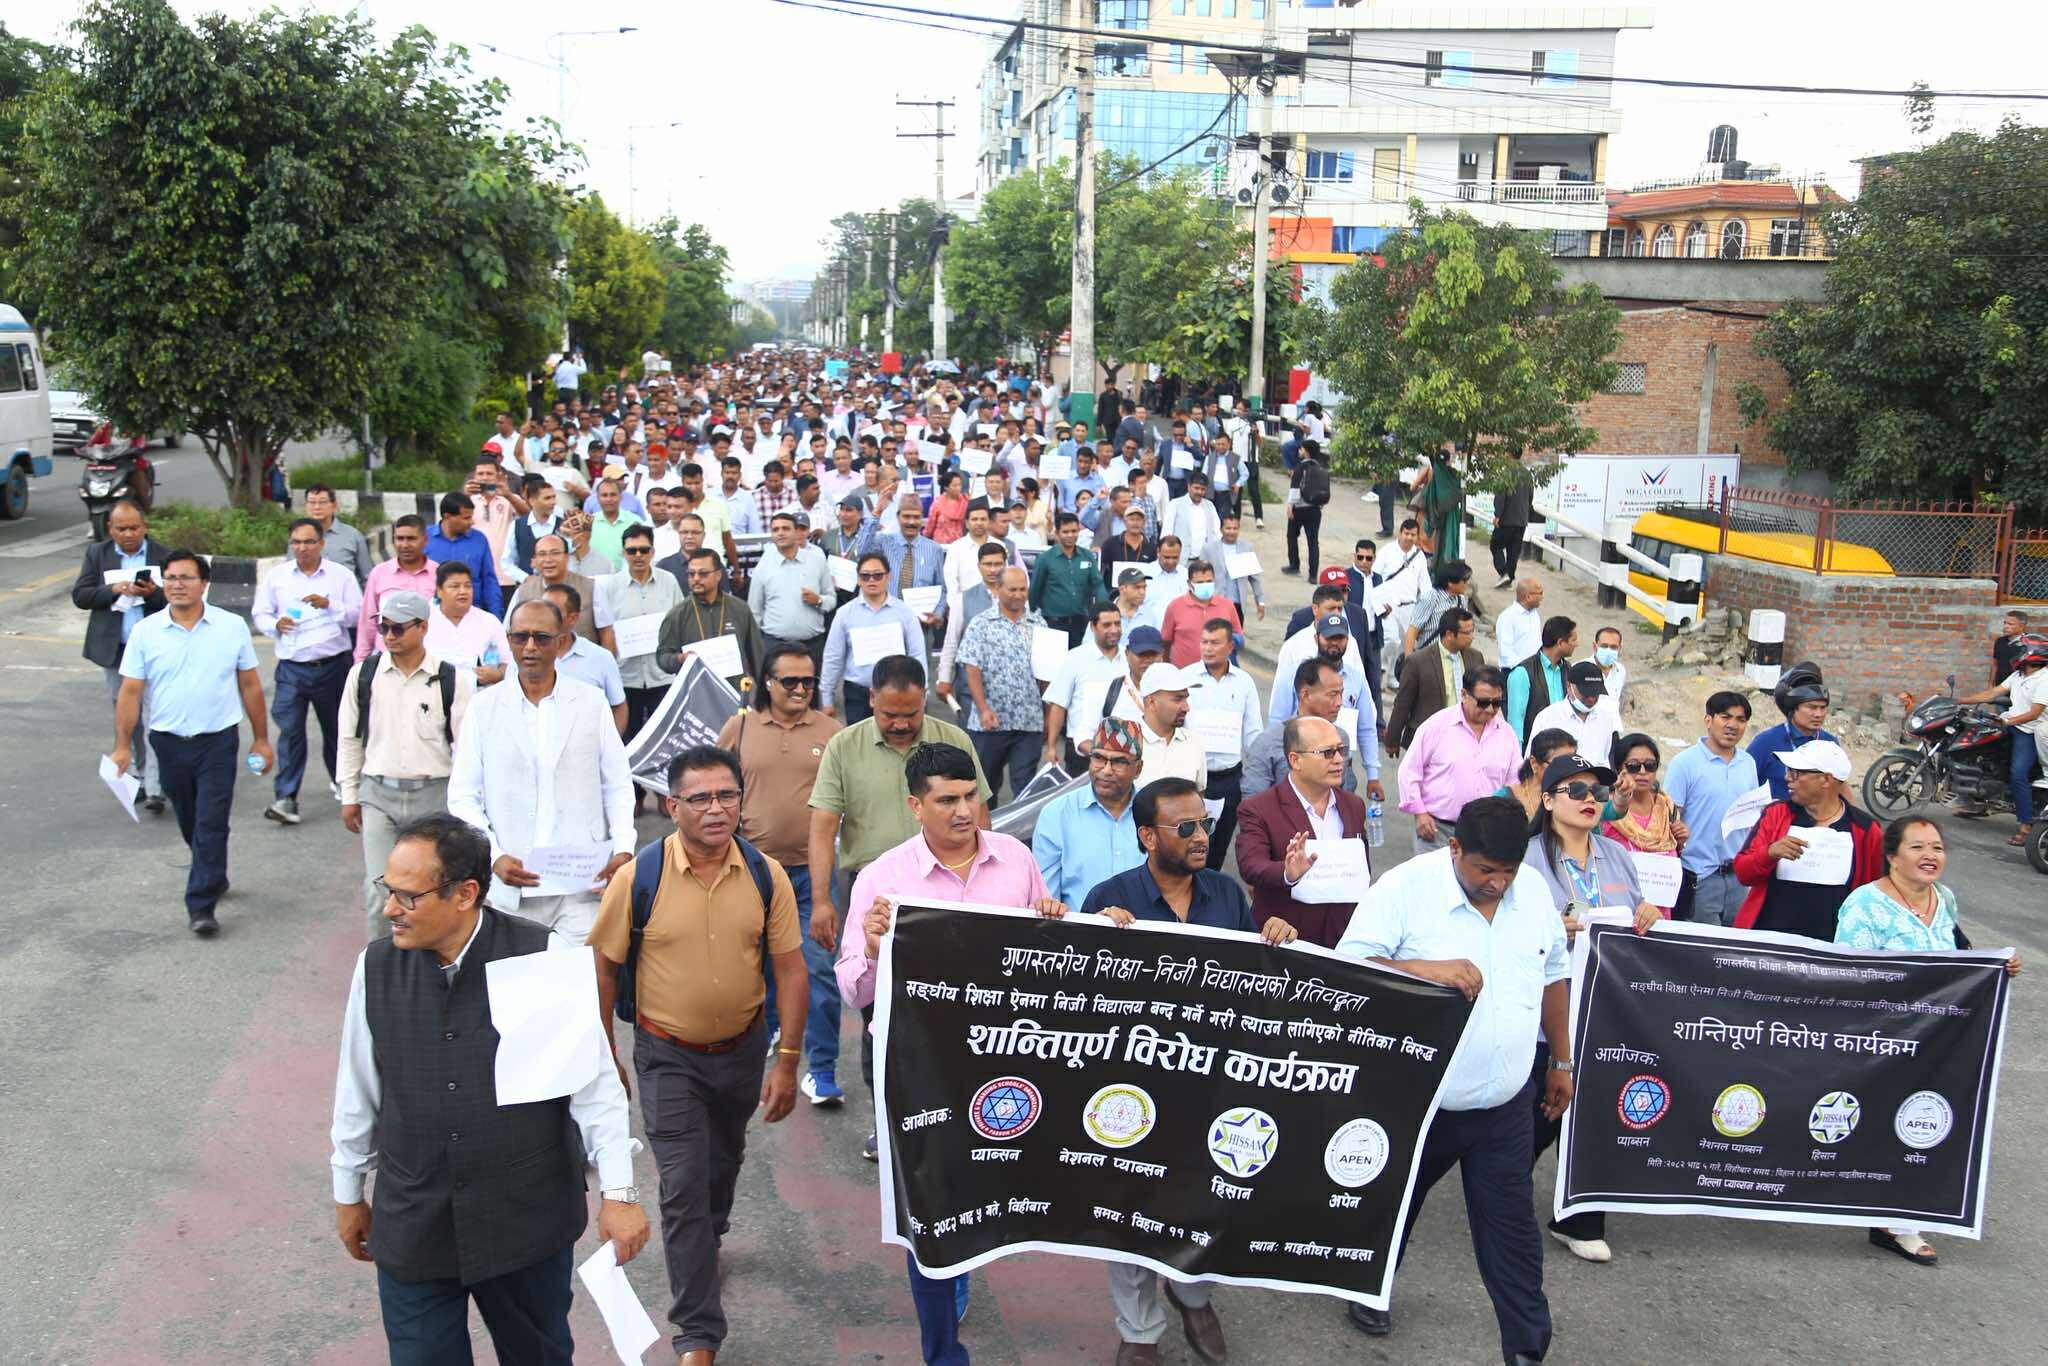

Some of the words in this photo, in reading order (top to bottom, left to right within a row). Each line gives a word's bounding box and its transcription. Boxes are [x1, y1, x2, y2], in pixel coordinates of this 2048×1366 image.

[1626, 488, 1648, 496] MEGA
[1649, 488, 1683, 496] COLLEGE
[1001, 945, 1091, 977] गुणस्तरीय
[1200, 960, 1292, 999] विद्यालयको
[1665, 981, 1687, 994] शिक्षा
[1690, 984, 1714, 996] ऐनमा
[905, 980, 959, 1003] सङ्घीय
[965, 982, 1004, 1006] शिक्षा
[1010, 987, 1049, 1011] ऐनमा
[1053, 990, 1088, 1013] निजी
[1092, 993, 1147, 1016] विद्यालय
[1150, 1001, 1176, 1021] बन्द
[1181, 1004, 1204, 1024] गर्ने
[1209, 1007, 1236, 1031] गरी
[1240, 1014, 1284, 1036] ल्याउन
[1287, 1017, 1345, 1043] लागिएको
[1348, 1026, 1396, 1051] नीतिका
[1673, 1016, 1764, 1050] शान्तिपूर्ण
[1768, 1021, 1828, 1050] विरोध
[1833, 1031, 1920, 1057] कार्यक्रम
[967, 1018, 1120, 1069] शान्तिपूर्ण
[1123, 1023, 1219, 1076] विरोध
[1223, 1050, 1359, 1094] कार्यक्रम
[1905, 1120, 1937, 1131] APEN
[1228, 1133, 1263, 1151] HISSAN
[1617, 1135, 1651, 1148] प्याब्सन
[1700, 1137, 1729, 1151] नेशनल
[1731, 1142, 1763, 1155] प्याब्सन
[970, 1148, 1023, 1162] प्याब्सन
[1058, 1147, 1109, 1168] नेशनल
[1113, 1155, 1168, 1179] प्याब्सन
[1339, 1155, 1372, 1165] APEN
[1811, 1148, 1837, 1161] हिसान
[1904, 1152, 1927, 1165] अपेन
[1210, 1176, 1254, 1200] हिसान
[1328, 1192, 1362, 1209] अपेन
[1130, 1211, 1165, 1234] विहान
[1168, 1226, 1185, 1239] ११
[1283, 1241, 1333, 1262] माइतीघर
[1335, 1248, 1376, 1263] मण्डला
